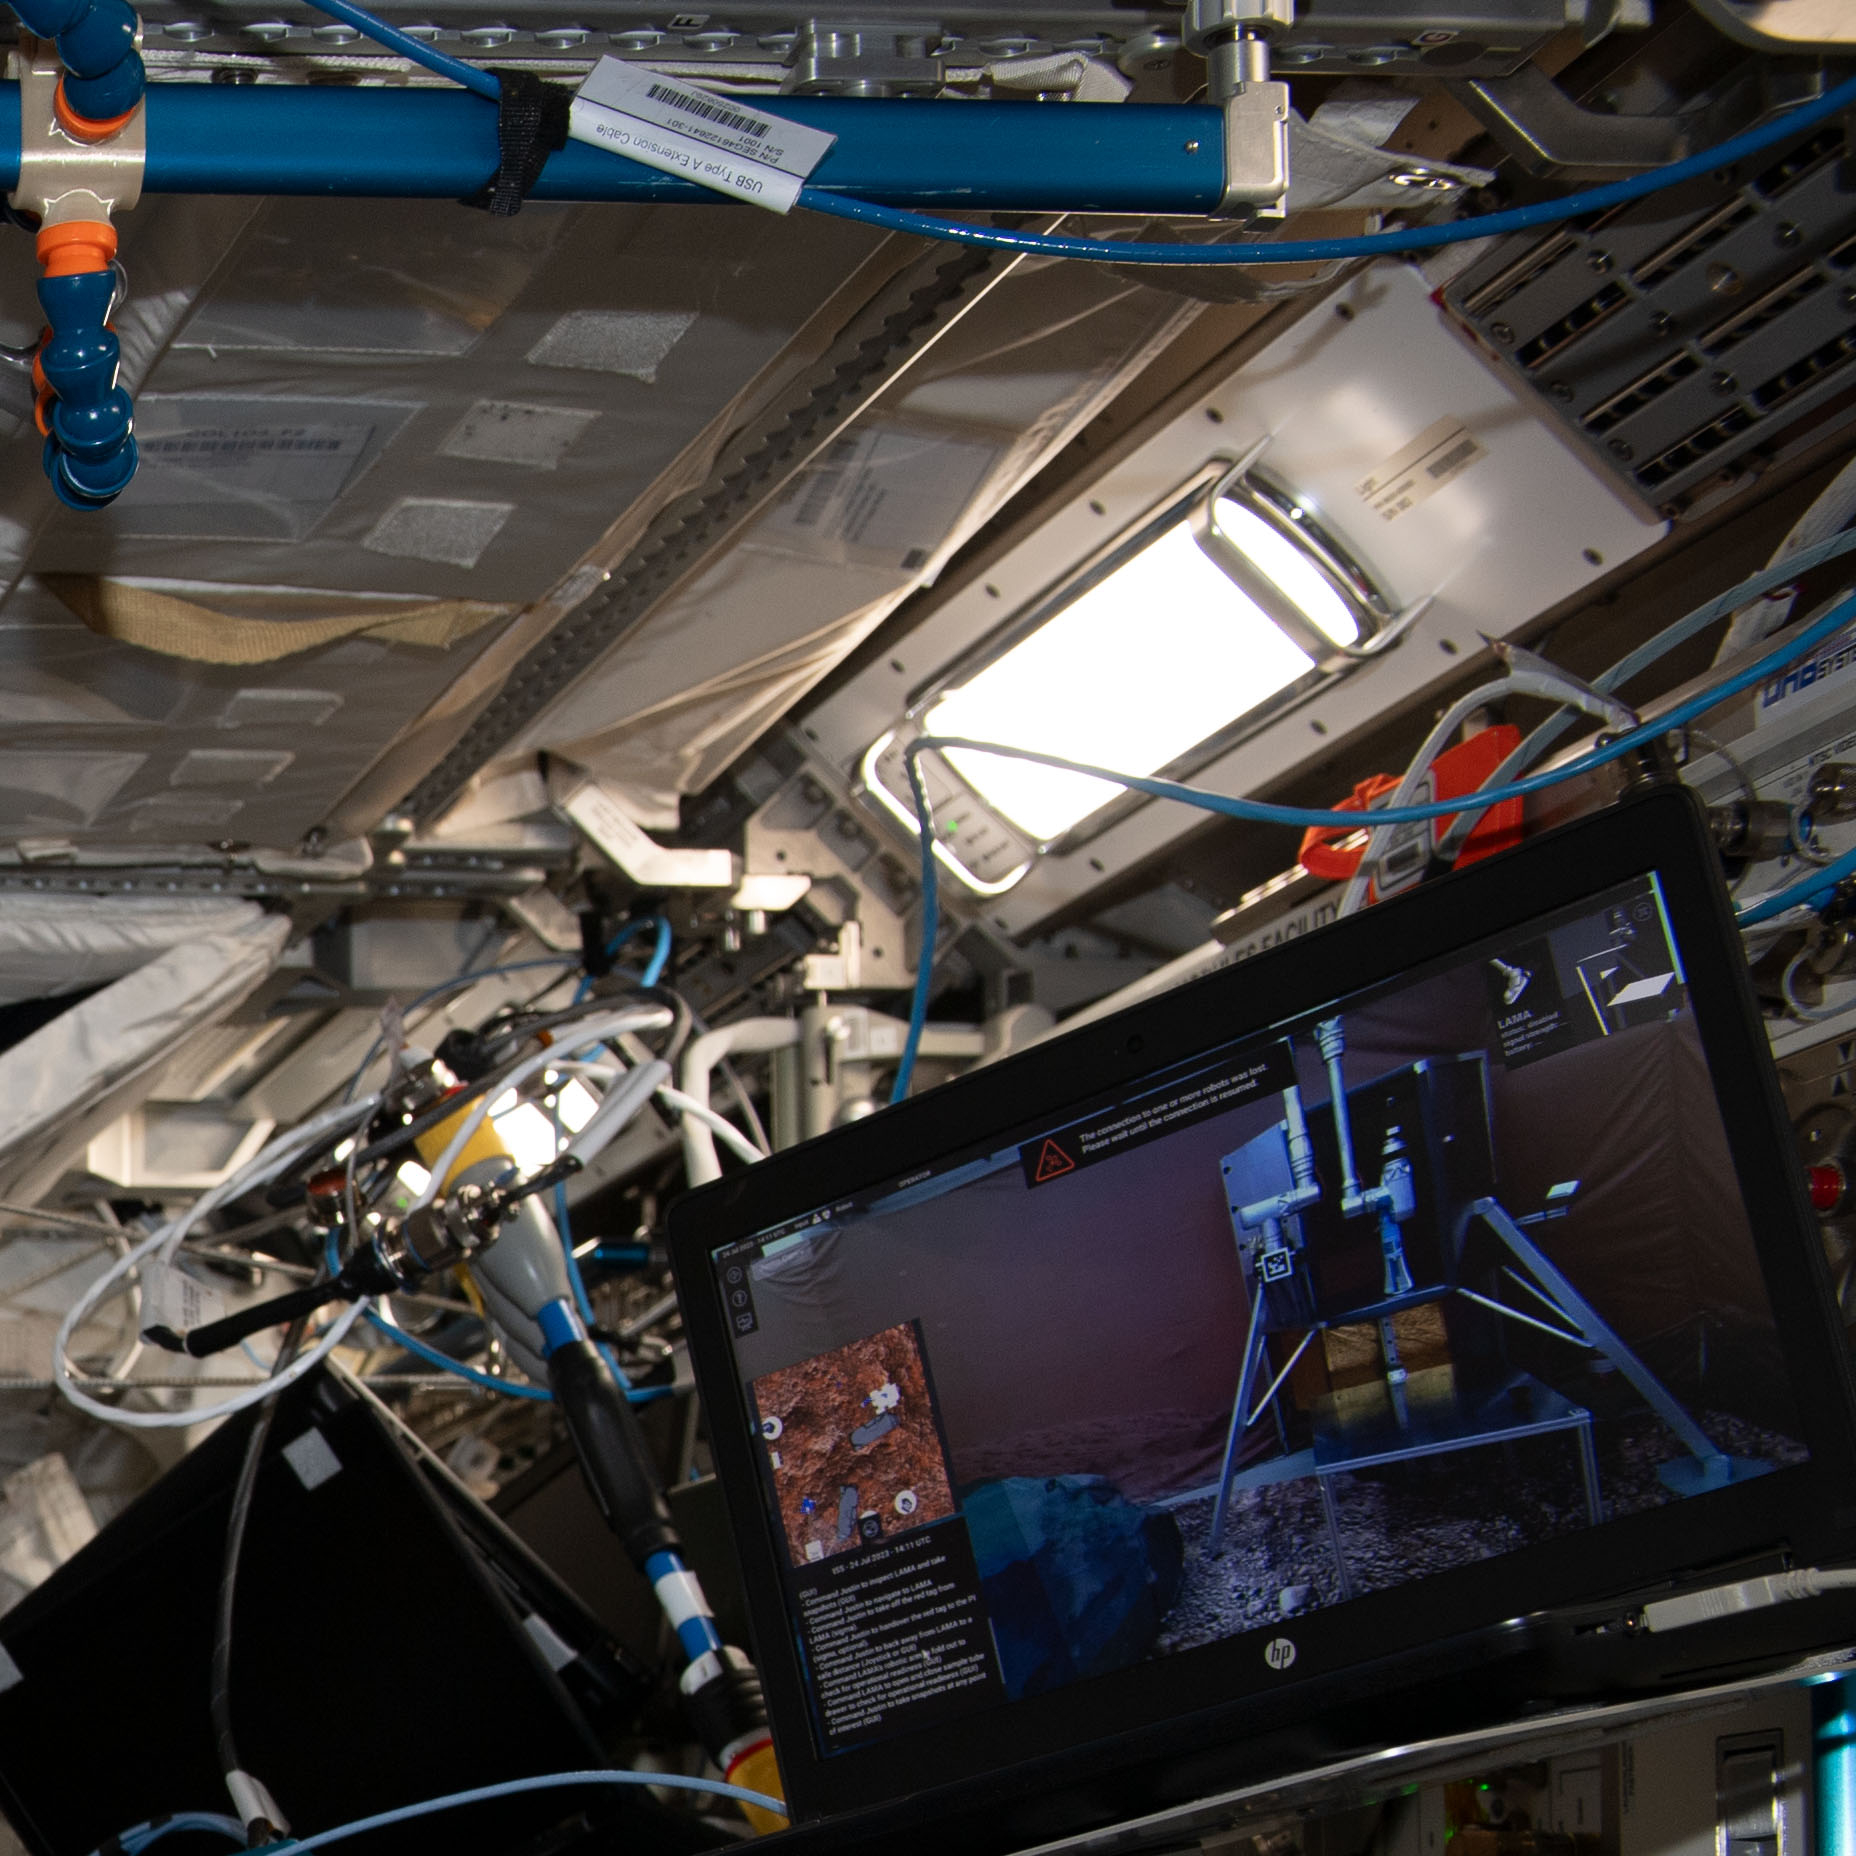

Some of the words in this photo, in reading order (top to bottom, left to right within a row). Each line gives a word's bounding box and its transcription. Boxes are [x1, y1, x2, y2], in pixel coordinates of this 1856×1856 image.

[595, 123, 631, 145] Cable
[631, 135, 690, 167] Extension
[758, 149, 779, 163] P/N
[691, 157, 703, 170] A
[703, 161, 733, 182] Type
[735, 173, 763, 193] USB
[1496, 1008, 1532, 1030] LAMA
[1079, 1129, 1096, 1143] The
[1096, 1112, 1142, 1136] connection
[1142, 1109, 1152, 1118] to
[1151, 1103, 1168, 1115] one
[1168, 1098, 1178, 1108] or
[1178, 1089, 1202, 1104] more
[1201, 1077, 1230, 1095] robots
[1230, 1071, 1248, 1083] was
[1248, 1062, 1267, 1076] lost.
[1081, 1137, 1110, 1154] Please
[1110, 1129, 1128, 1142] wait
[1128, 1121, 1148, 1135] until
[1147, 1116, 1162, 1128] the
[1162, 1097, 1210, 1122] connection
[1210, 1094, 1218, 1103] is
[1218, 1078, 1259, 1100] resumed.
[1267, 1639, 1295, 1669] hp
